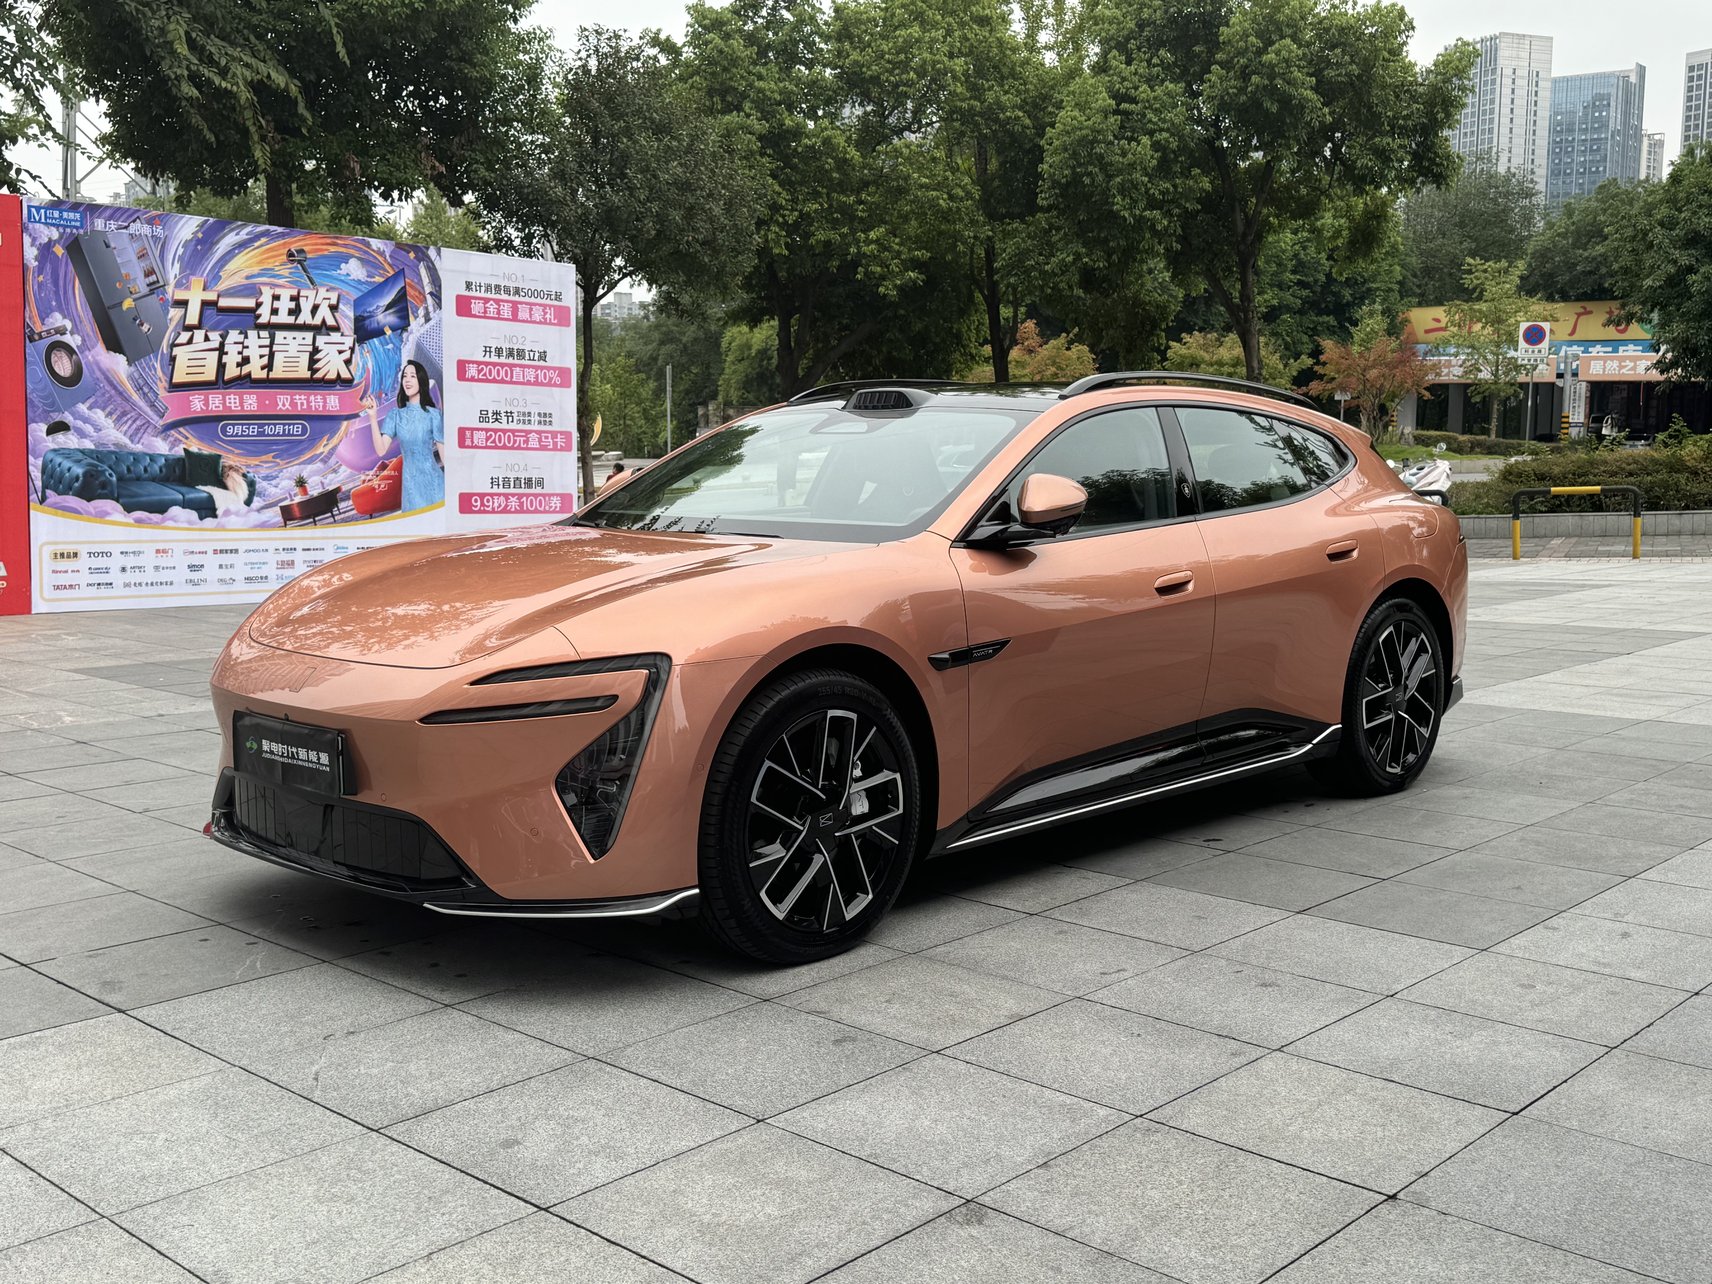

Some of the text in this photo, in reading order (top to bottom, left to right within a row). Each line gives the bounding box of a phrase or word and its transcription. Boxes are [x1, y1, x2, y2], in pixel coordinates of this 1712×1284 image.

[46, 218, 81, 227] MACALLINE
[94, 218, 164, 237] 重庆二郎商场
[502, 272, 525, 283] NO.1
[464, 280, 563, 302] 累计消费每满5000元起
[173, 277, 340, 329] 十一狂欢
[470, 299, 558, 324] 砸金蛋 赢豪礼
[503, 334, 527, 346] NO.2
[171, 330, 357, 386] 省钱置家
[482, 345, 548, 363] 开单满额立减
[504, 397, 528, 408] NO.3
[478, 409, 515, 425] 品类节
[226, 424, 302, 436] 9月5日-10月11日
[505, 463, 528, 473] NO.4
[490, 476, 545, 490] 抖音直播间
[261, 739, 330, 765] 聚电时代新能源
